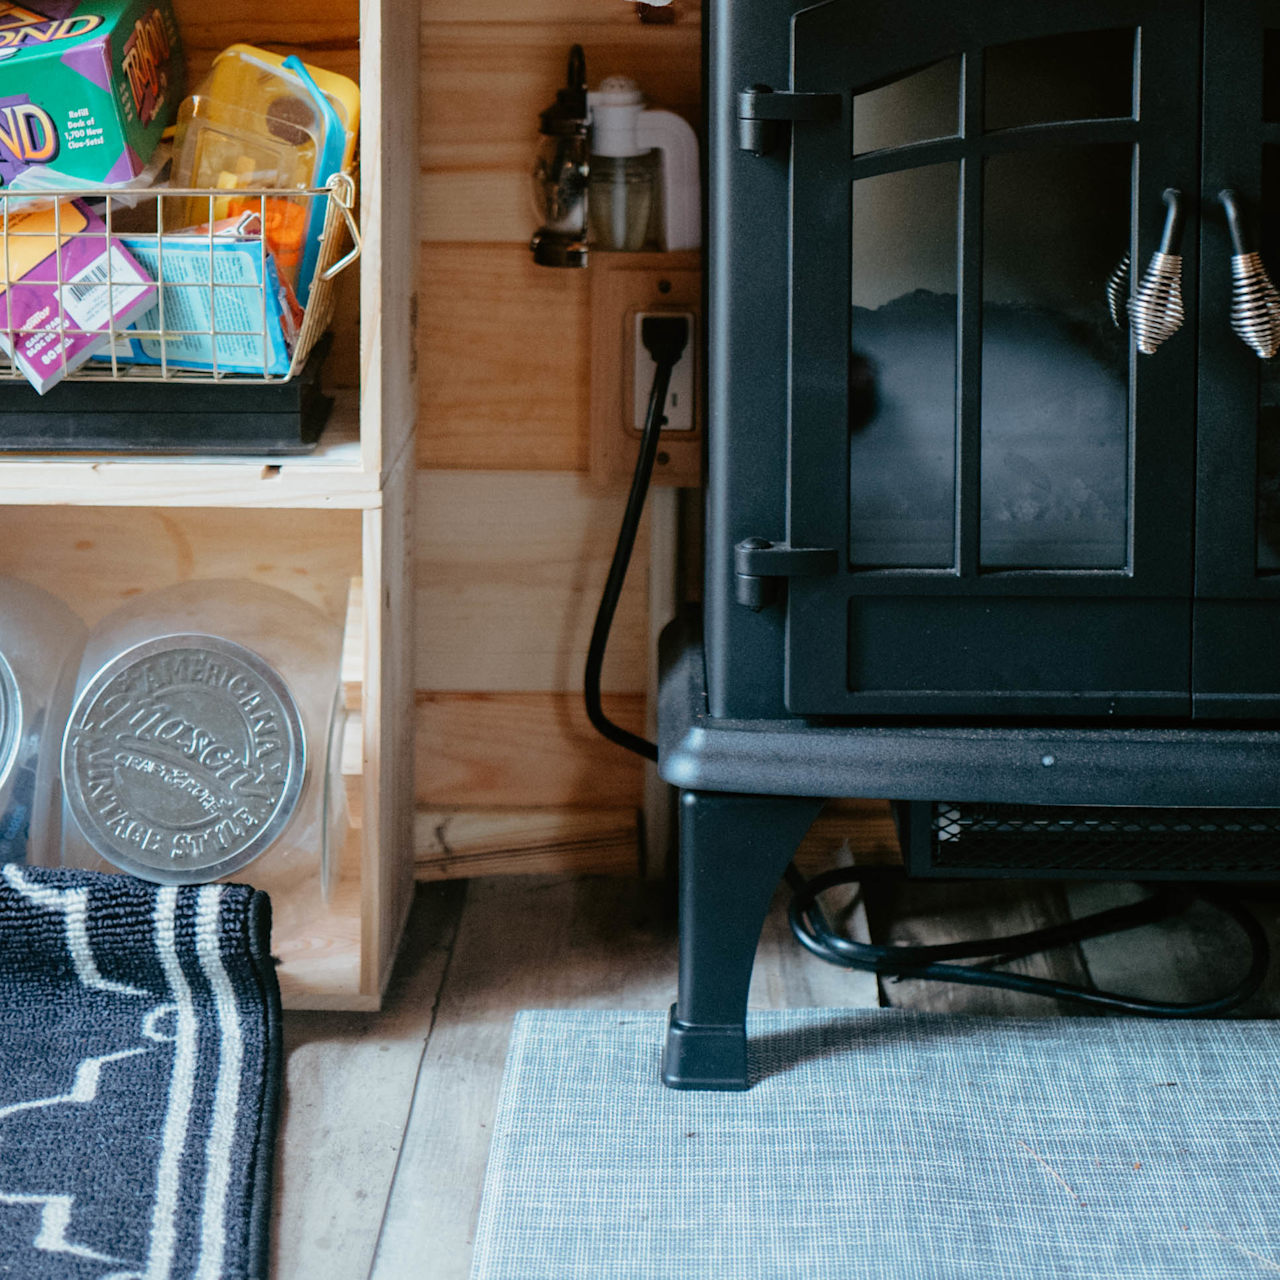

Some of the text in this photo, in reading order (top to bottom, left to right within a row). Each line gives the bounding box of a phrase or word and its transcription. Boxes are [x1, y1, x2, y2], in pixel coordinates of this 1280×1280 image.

[69, 108, 89, 119] Refill
[67, 117, 95, 129] Deck of
[64, 127, 103, 141] 1,700 New
[88, 748, 162, 851] VINTAGE
